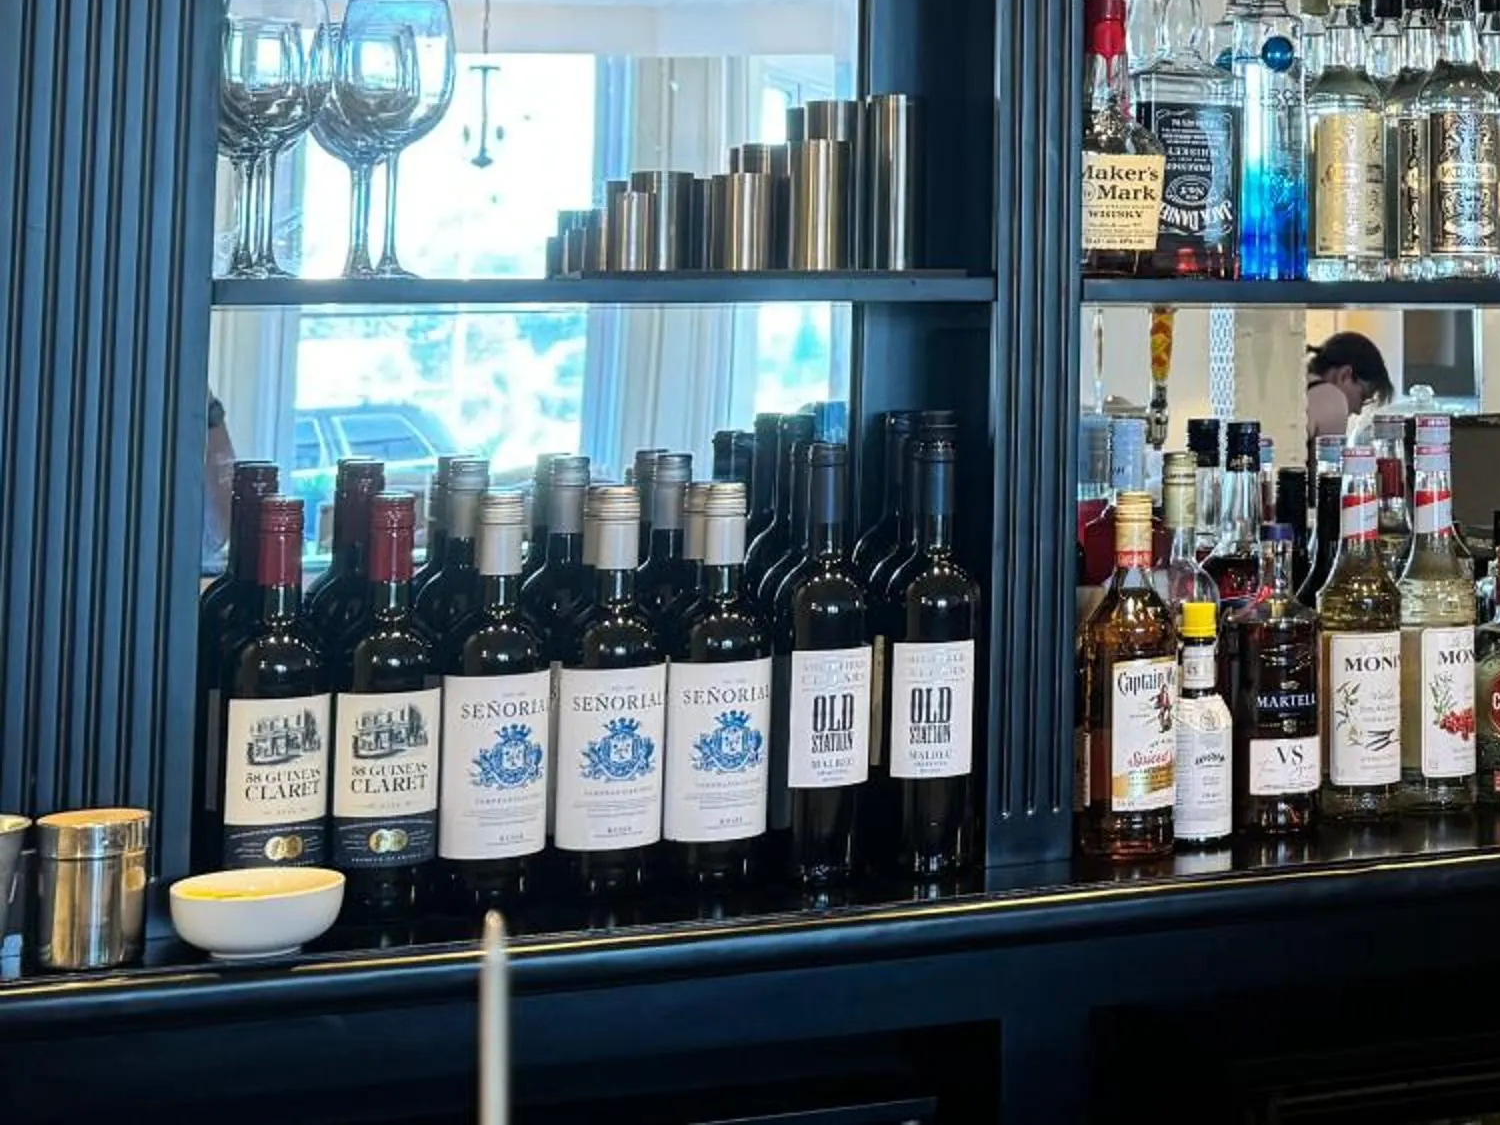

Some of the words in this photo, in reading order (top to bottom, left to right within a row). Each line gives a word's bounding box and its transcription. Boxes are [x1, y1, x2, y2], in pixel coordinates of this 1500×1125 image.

[1097, 185, 1156, 200] Mark
[1159, 203, 1199, 231] DANIE
[1438, 649, 1475, 665] MON
[1117, 669, 1163, 695] Captain
[461, 698, 546, 720] SEÑORIA
[814, 693, 854, 732] OLD
[911, 687, 952, 724] OLD
[1276, 745, 1303, 765] VS
[245, 780, 320, 800] CLARET
[351, 774, 428, 794] CLARET
